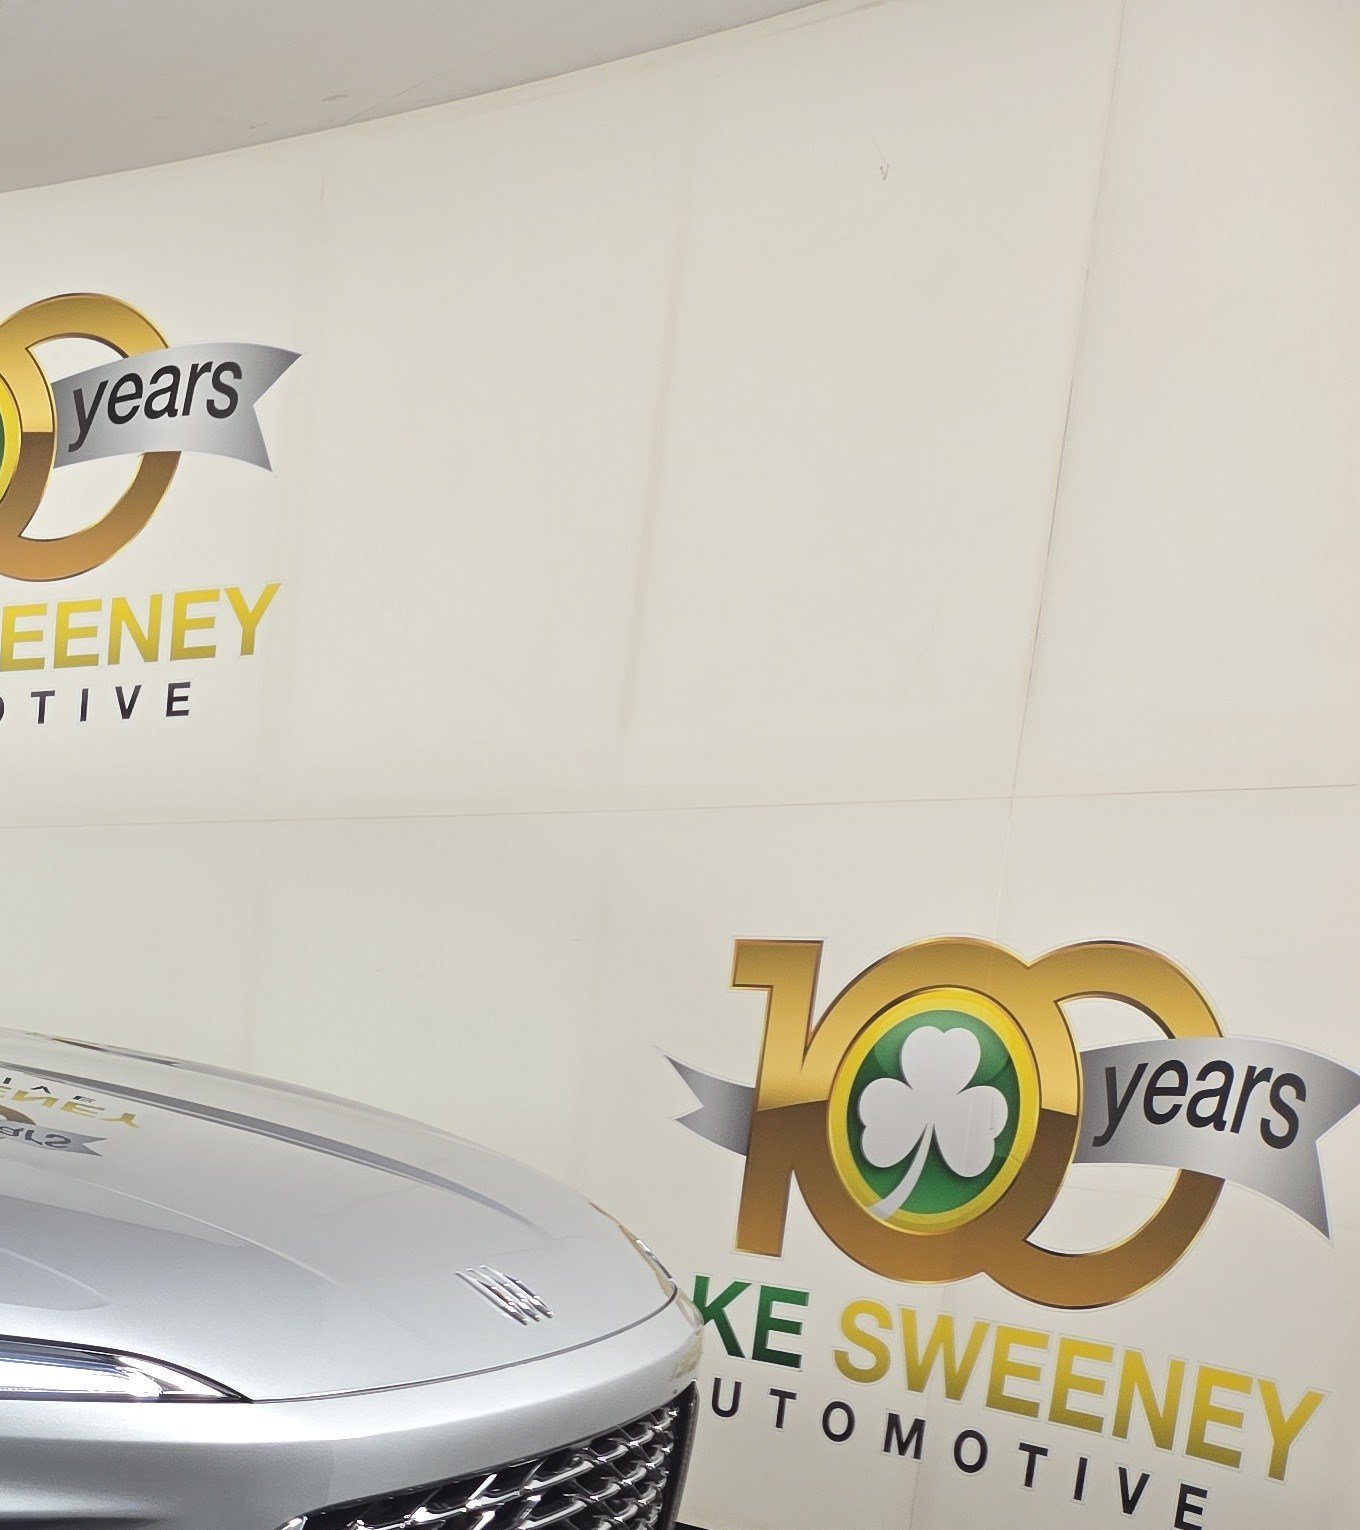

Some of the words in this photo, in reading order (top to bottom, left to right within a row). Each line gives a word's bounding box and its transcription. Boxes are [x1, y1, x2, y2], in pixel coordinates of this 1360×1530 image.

[67, 359, 243, 453] years
[731, 936, 1226, 1310] 100
[1091, 1055, 1308, 1150] years
[692, 1273, 811, 1370] KE
[833, 1300, 1324, 1482] SWEENEY
